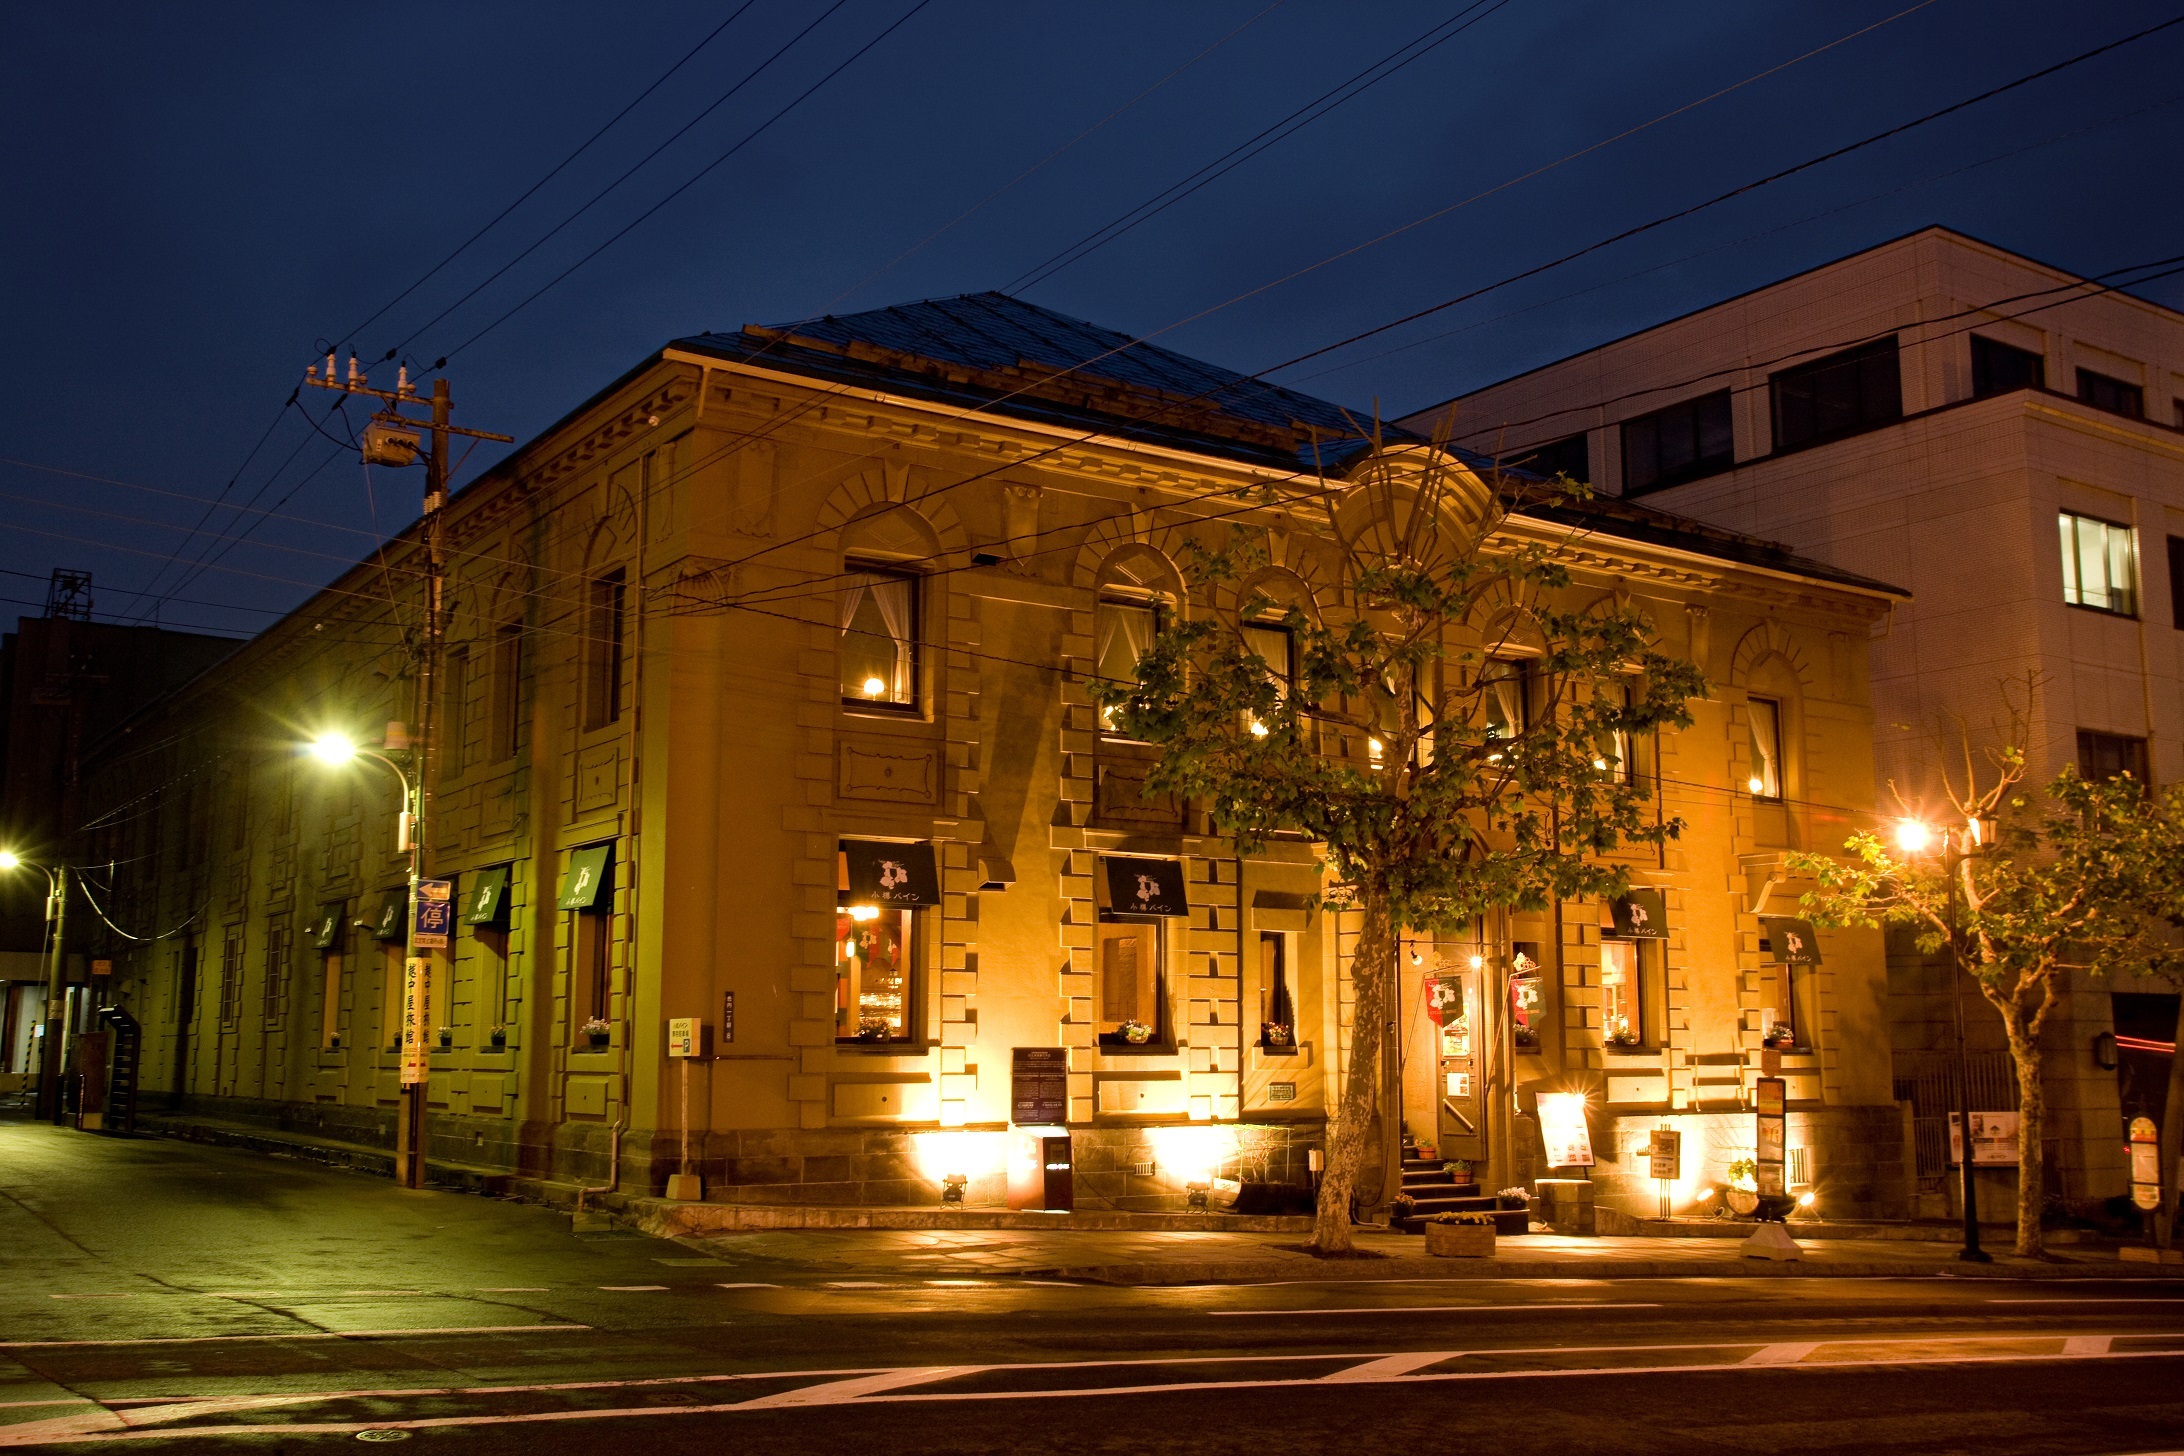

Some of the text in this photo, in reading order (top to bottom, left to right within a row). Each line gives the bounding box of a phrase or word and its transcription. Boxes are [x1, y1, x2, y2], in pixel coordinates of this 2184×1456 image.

[870, 890, 920, 901] 小樽バイン
[420, 907, 444, 929] 停
